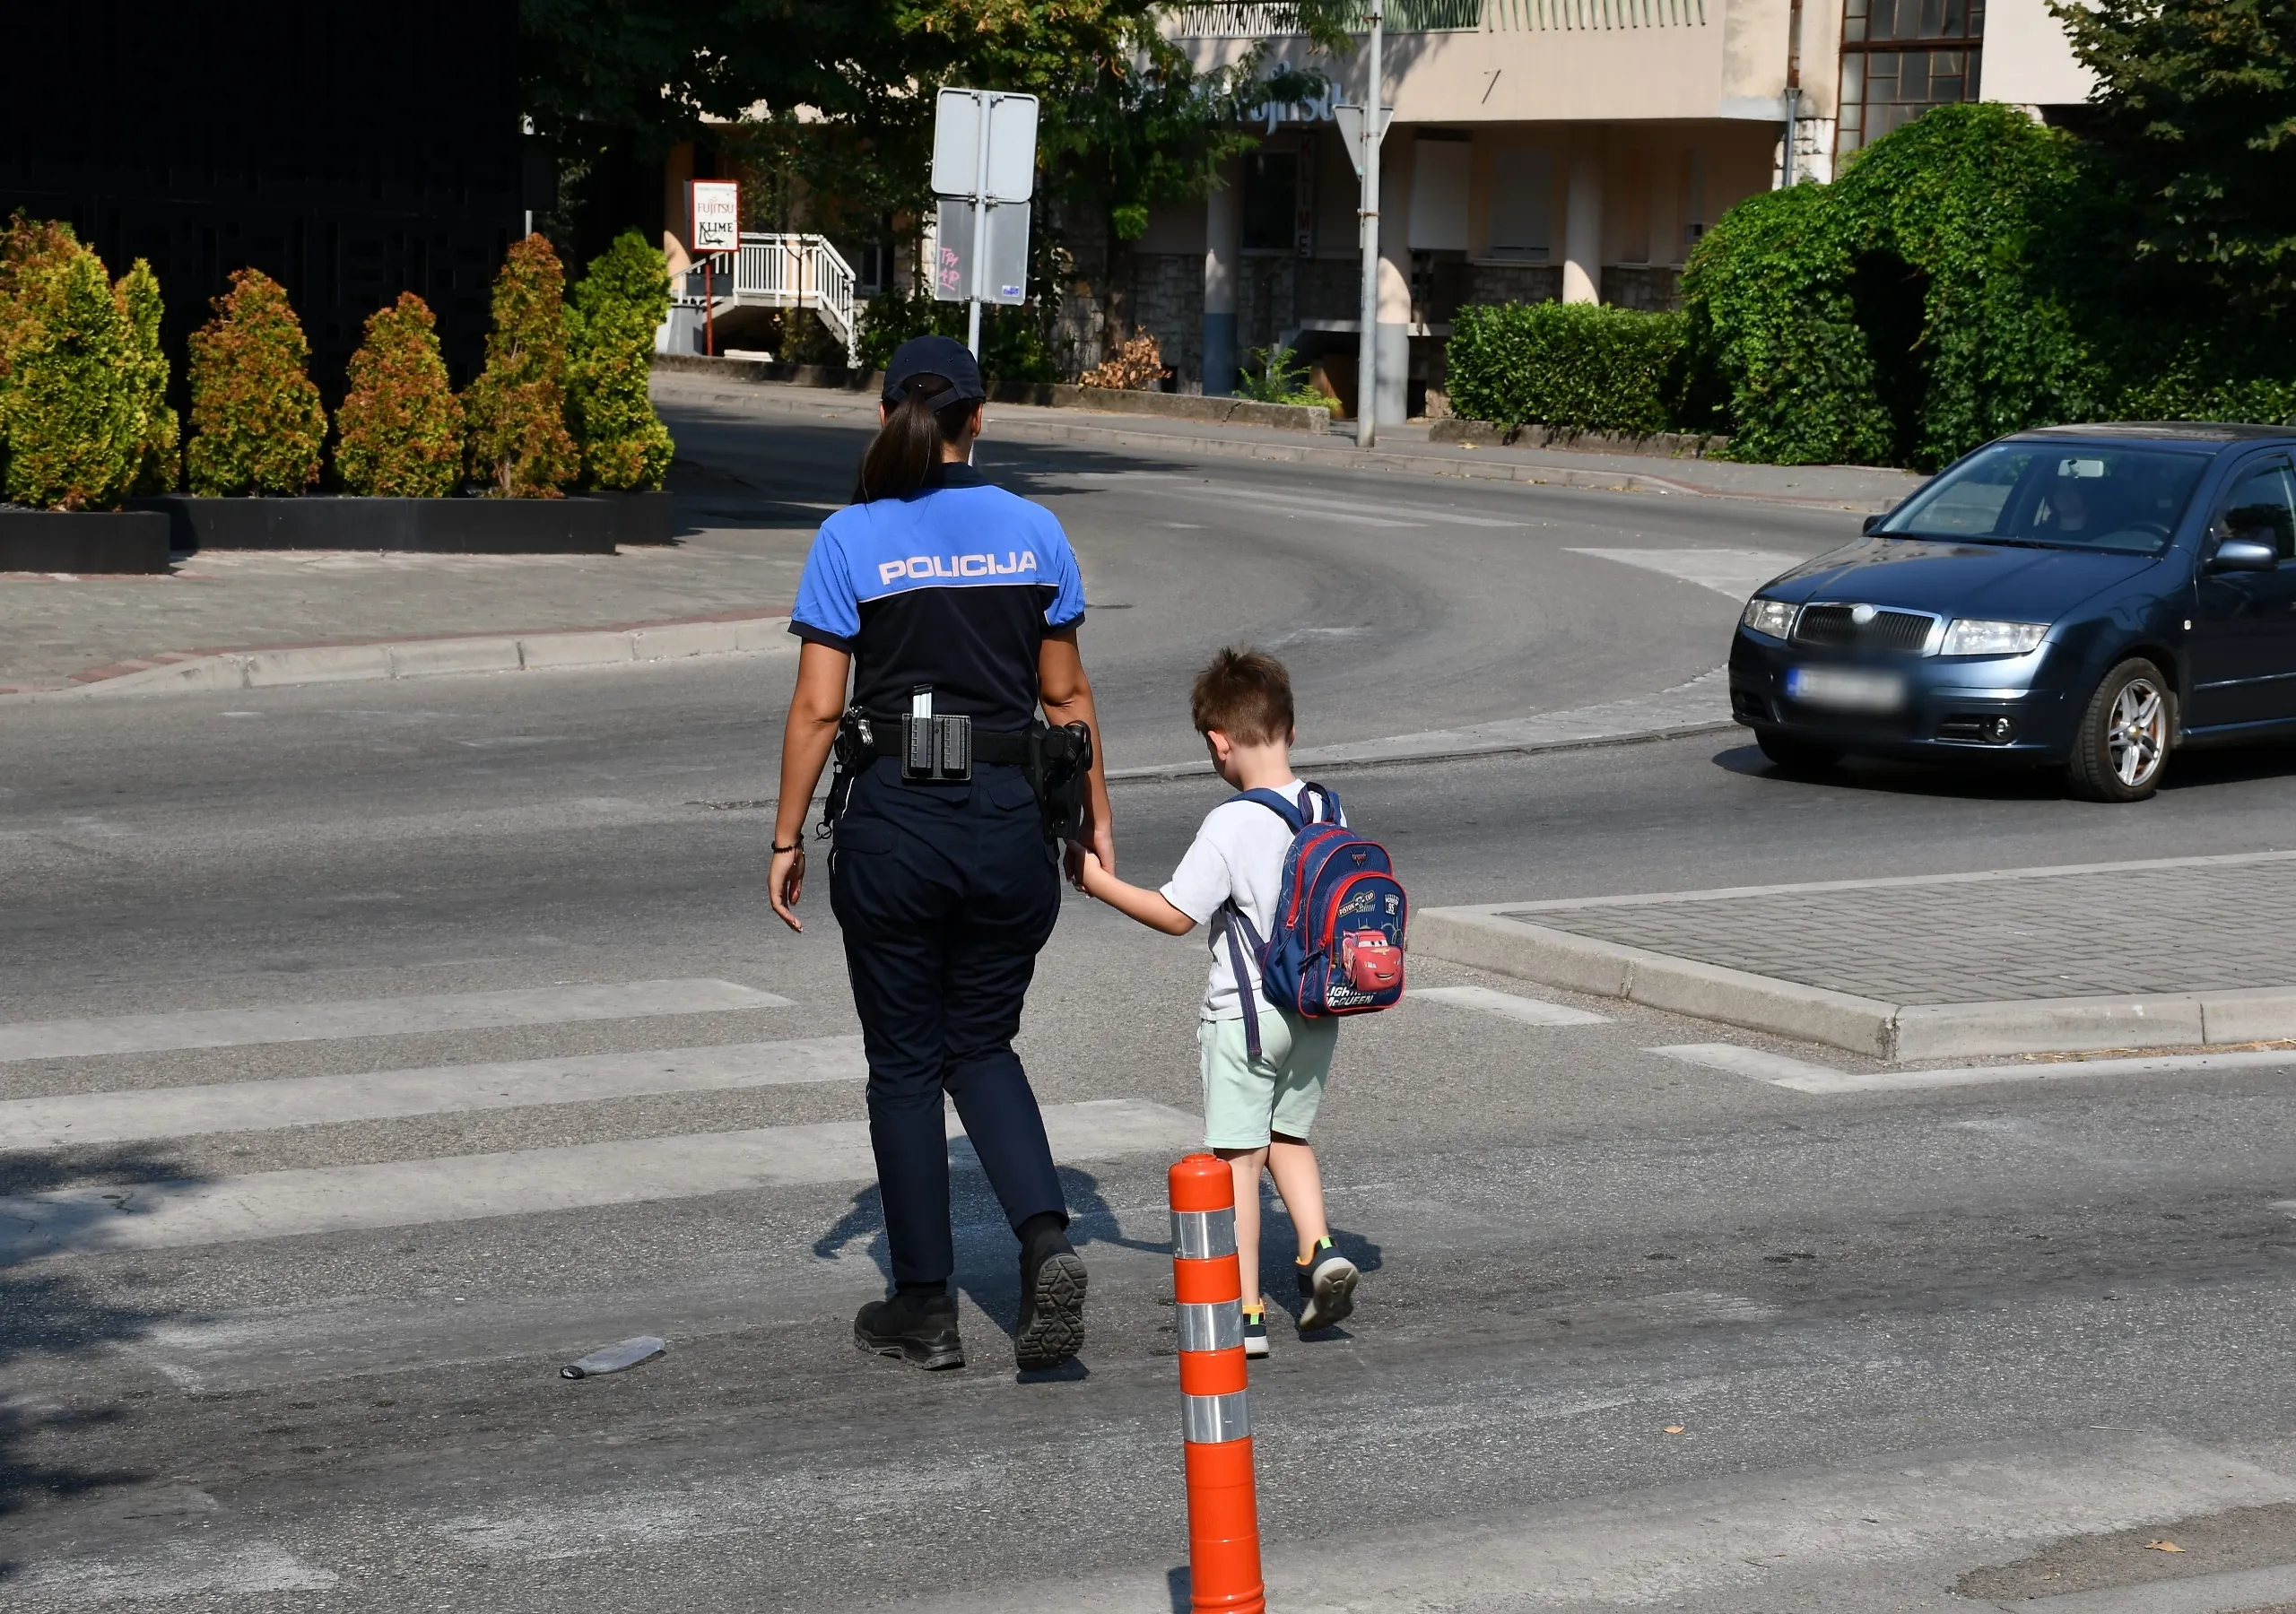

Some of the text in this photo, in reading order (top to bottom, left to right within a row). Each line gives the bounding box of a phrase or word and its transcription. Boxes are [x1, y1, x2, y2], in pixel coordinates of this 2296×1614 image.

[698, 203, 734, 215] FUJITSU
[699, 221, 734, 233] KLIME
[878, 551, 1037, 586] POLICIJA
